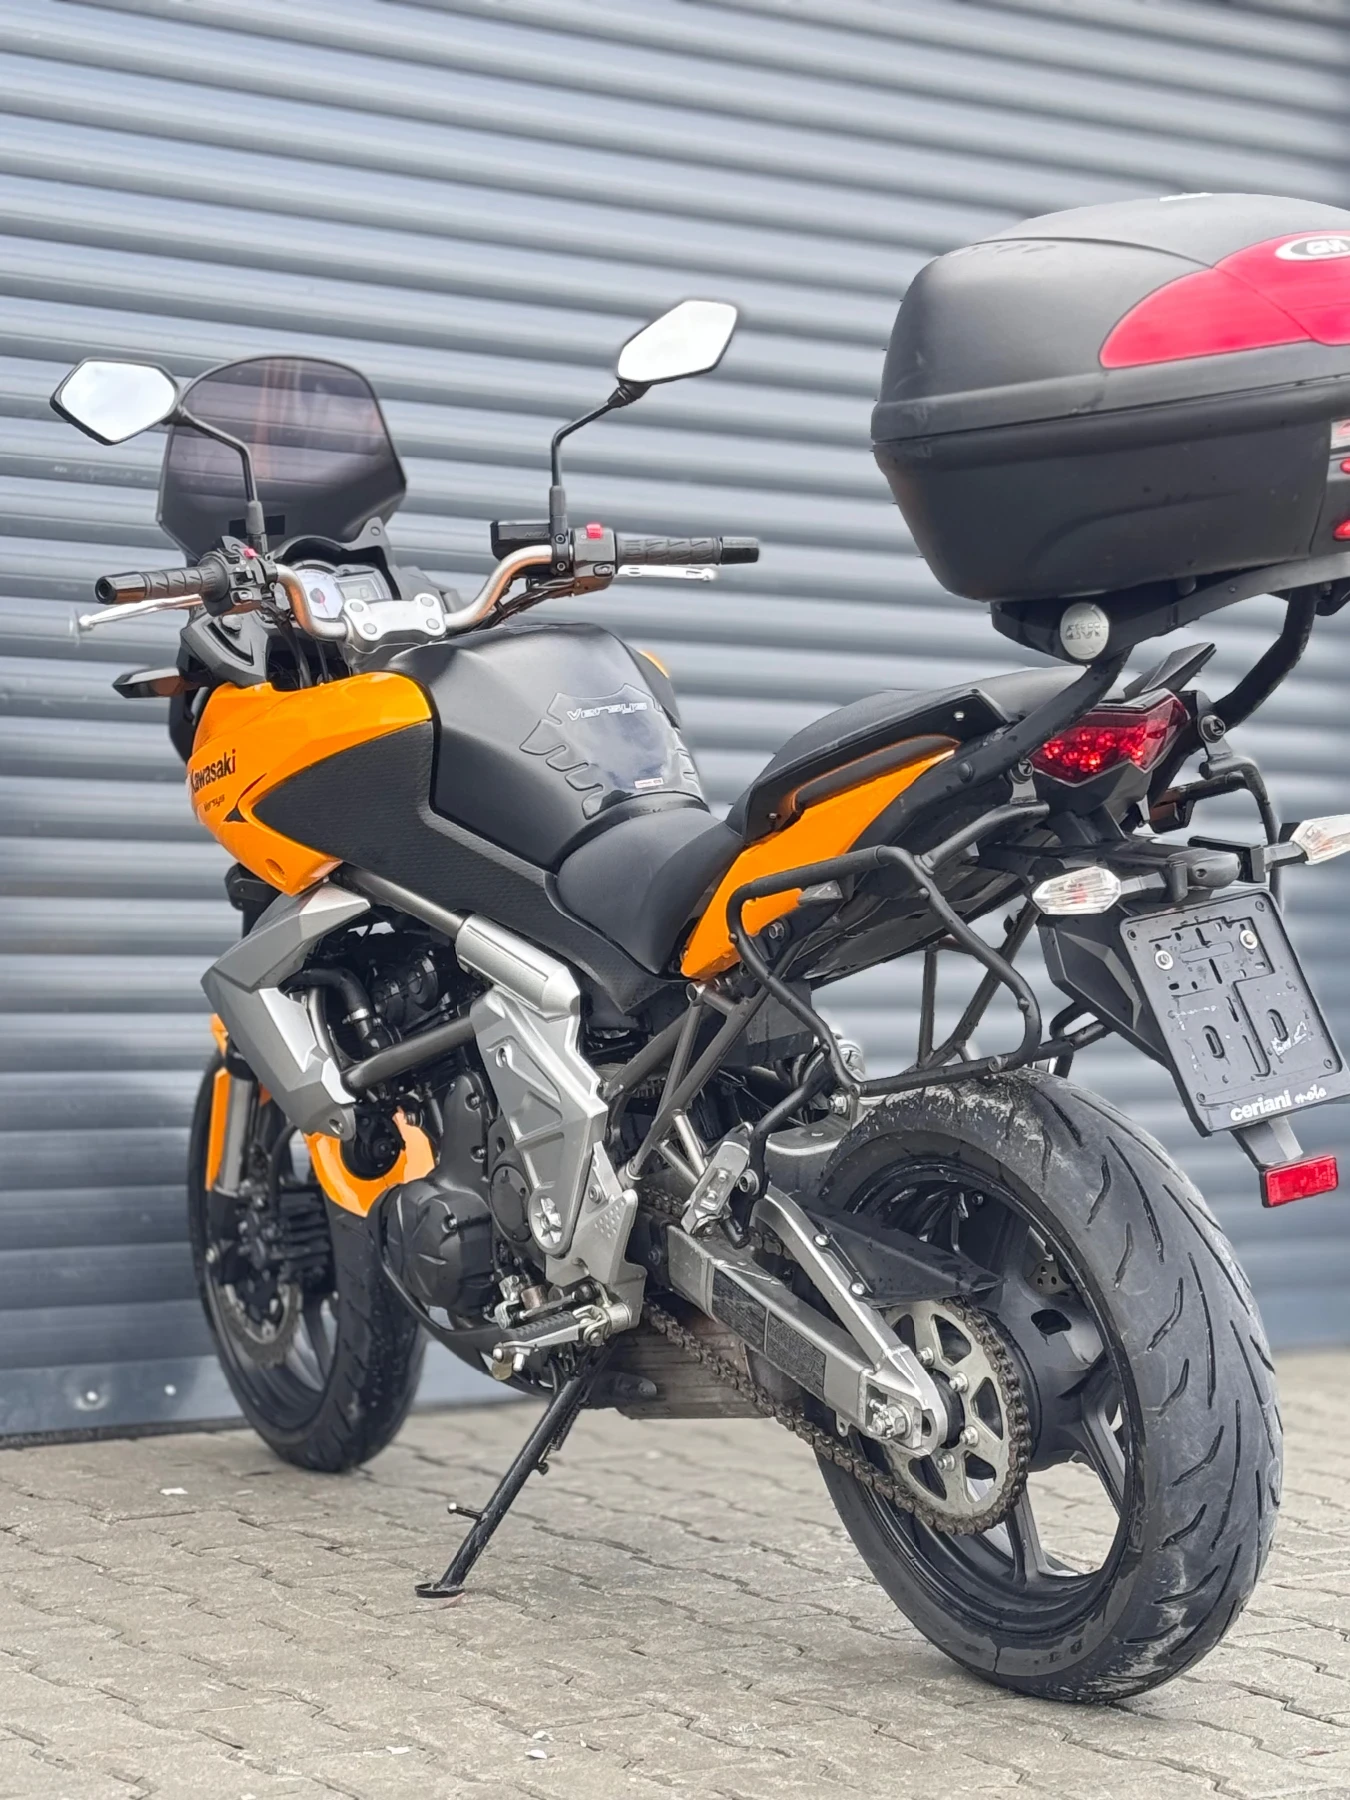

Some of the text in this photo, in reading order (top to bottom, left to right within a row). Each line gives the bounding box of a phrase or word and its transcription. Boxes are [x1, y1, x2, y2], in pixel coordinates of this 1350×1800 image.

[566, 702, 649, 721] Versys
[191, 749, 236, 793] Kawasaki
[1230, 1083, 1327, 1121] ceriani moto
